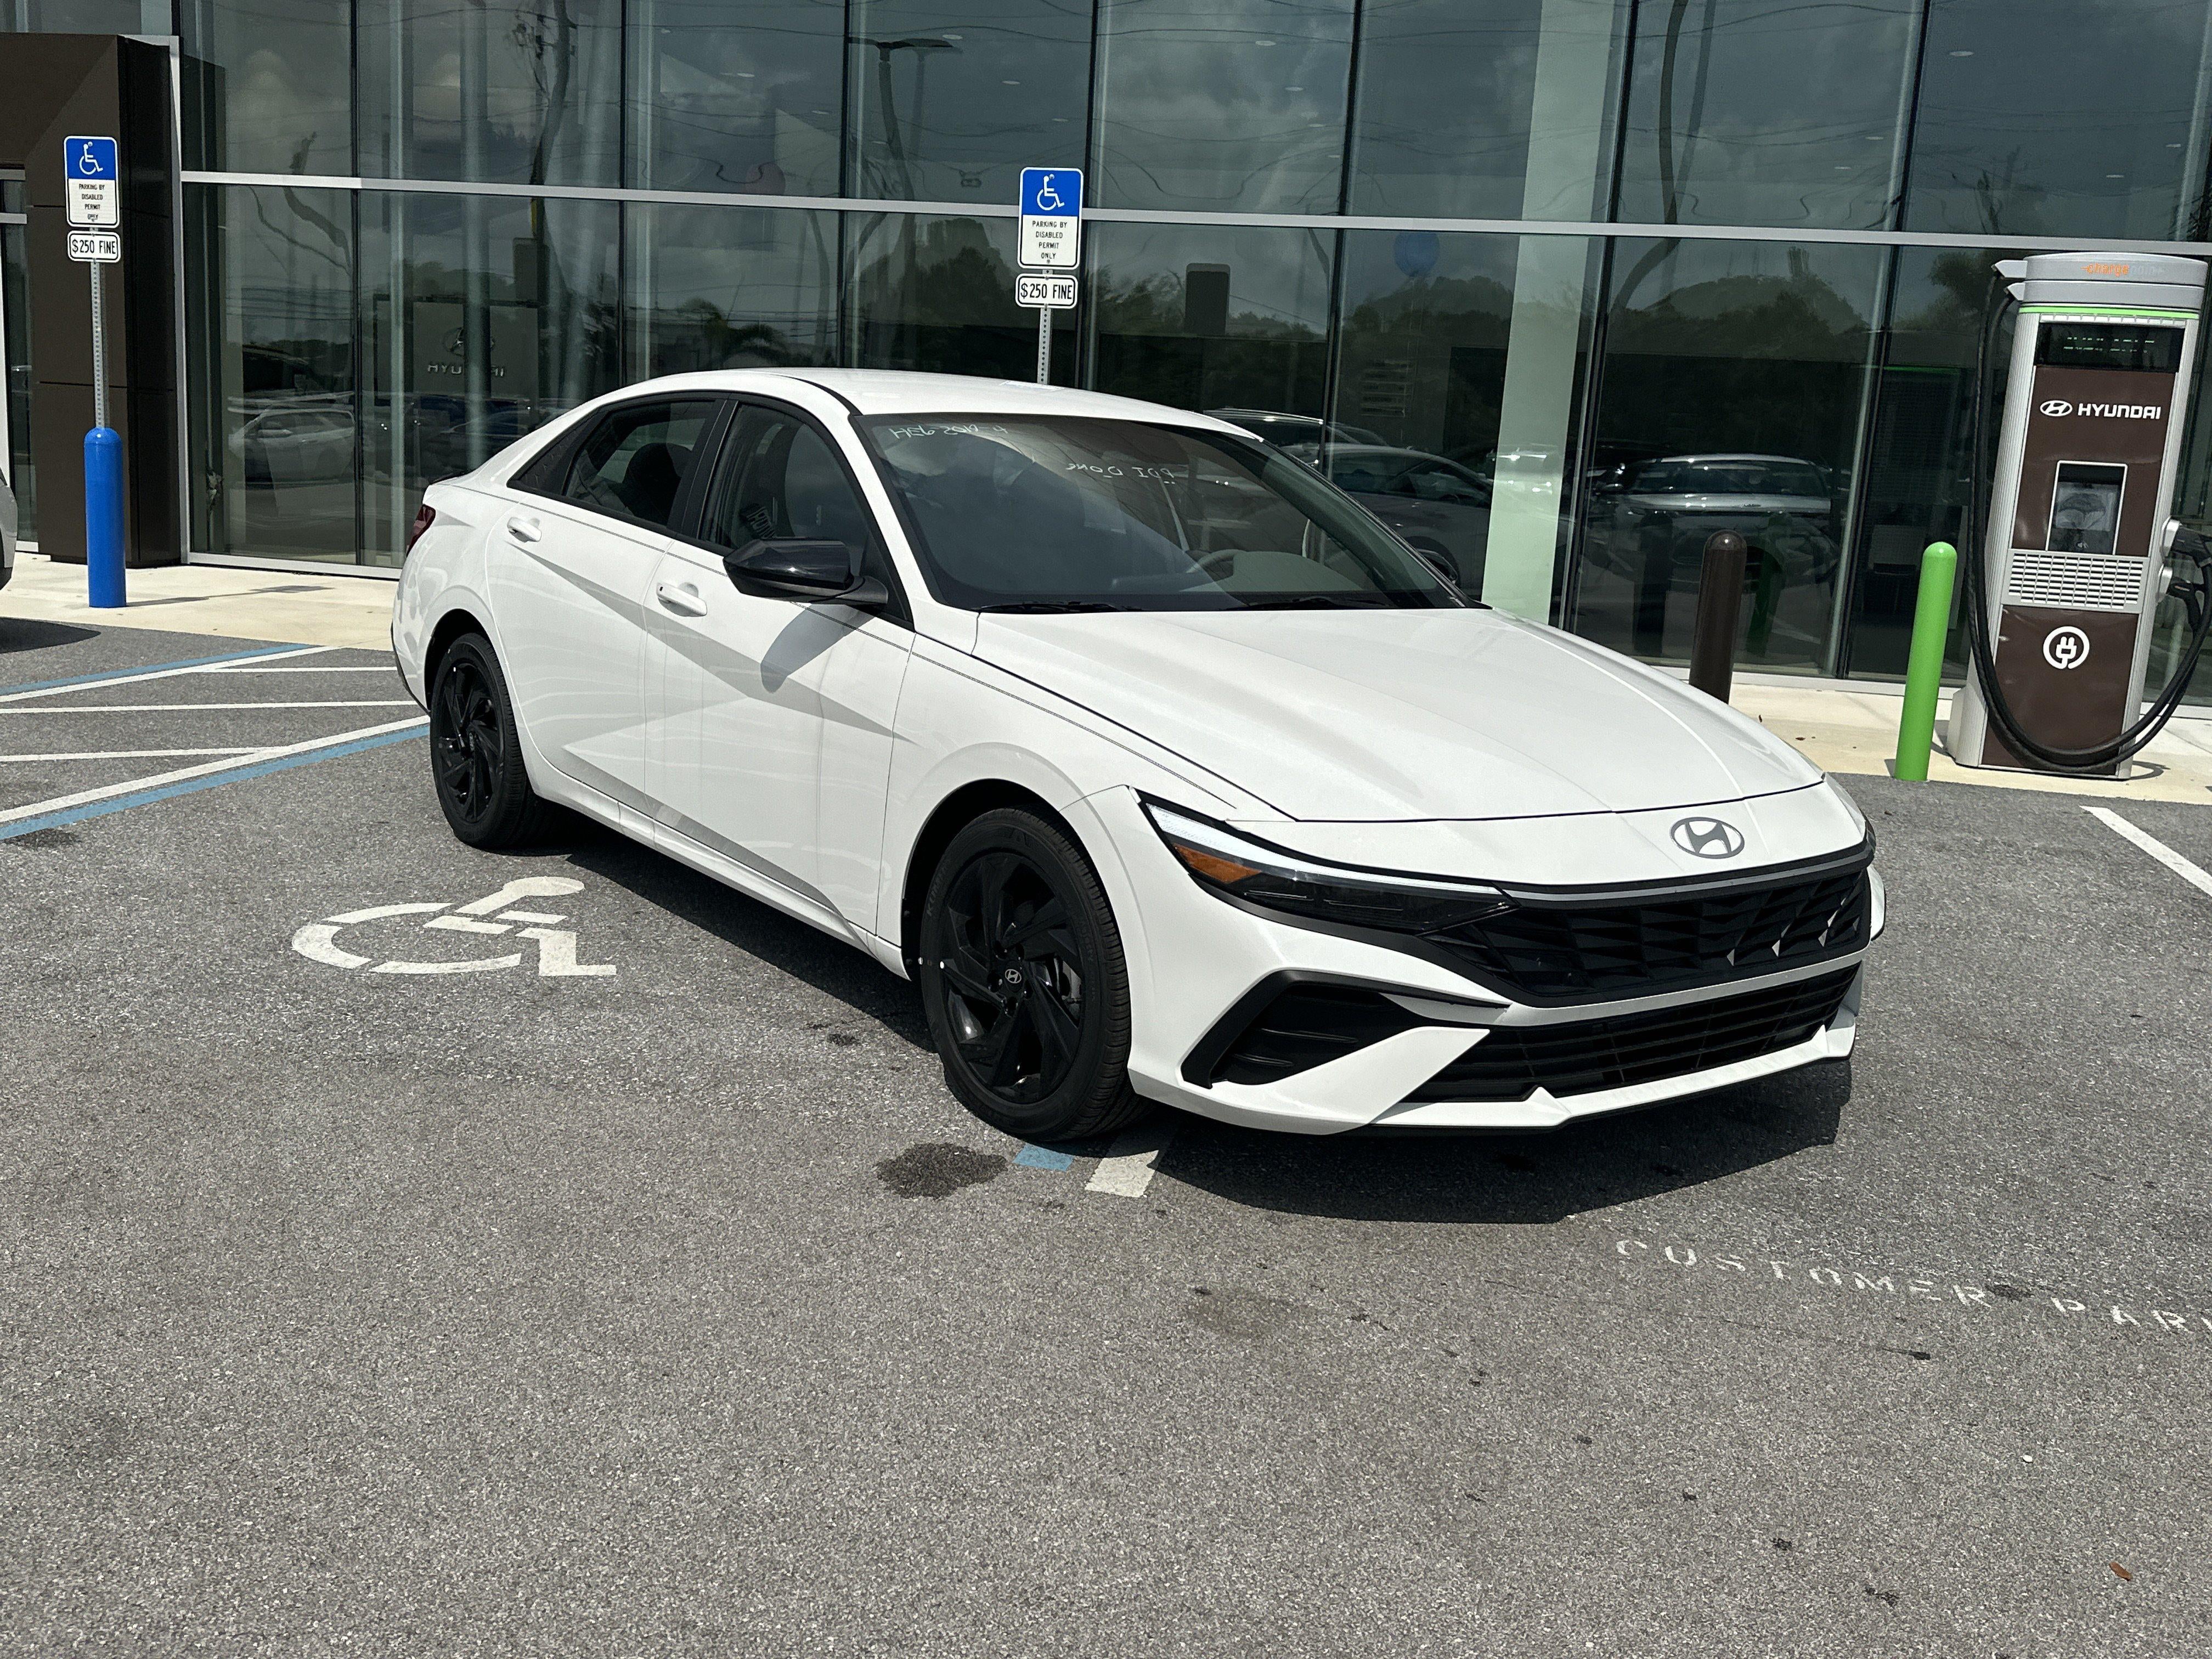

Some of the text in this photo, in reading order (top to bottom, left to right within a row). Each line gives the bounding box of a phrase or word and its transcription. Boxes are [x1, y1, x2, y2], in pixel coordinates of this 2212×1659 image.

[72, 239, 116, 254] $250 FINE
[1020, 283, 1073, 300] $250 FINE
[427, 363, 505, 377] HYUAI
[2078, 403, 2161, 420] HYUNDAI
[1617, 1239, 2212, 1333] CUSTOMER PAR
